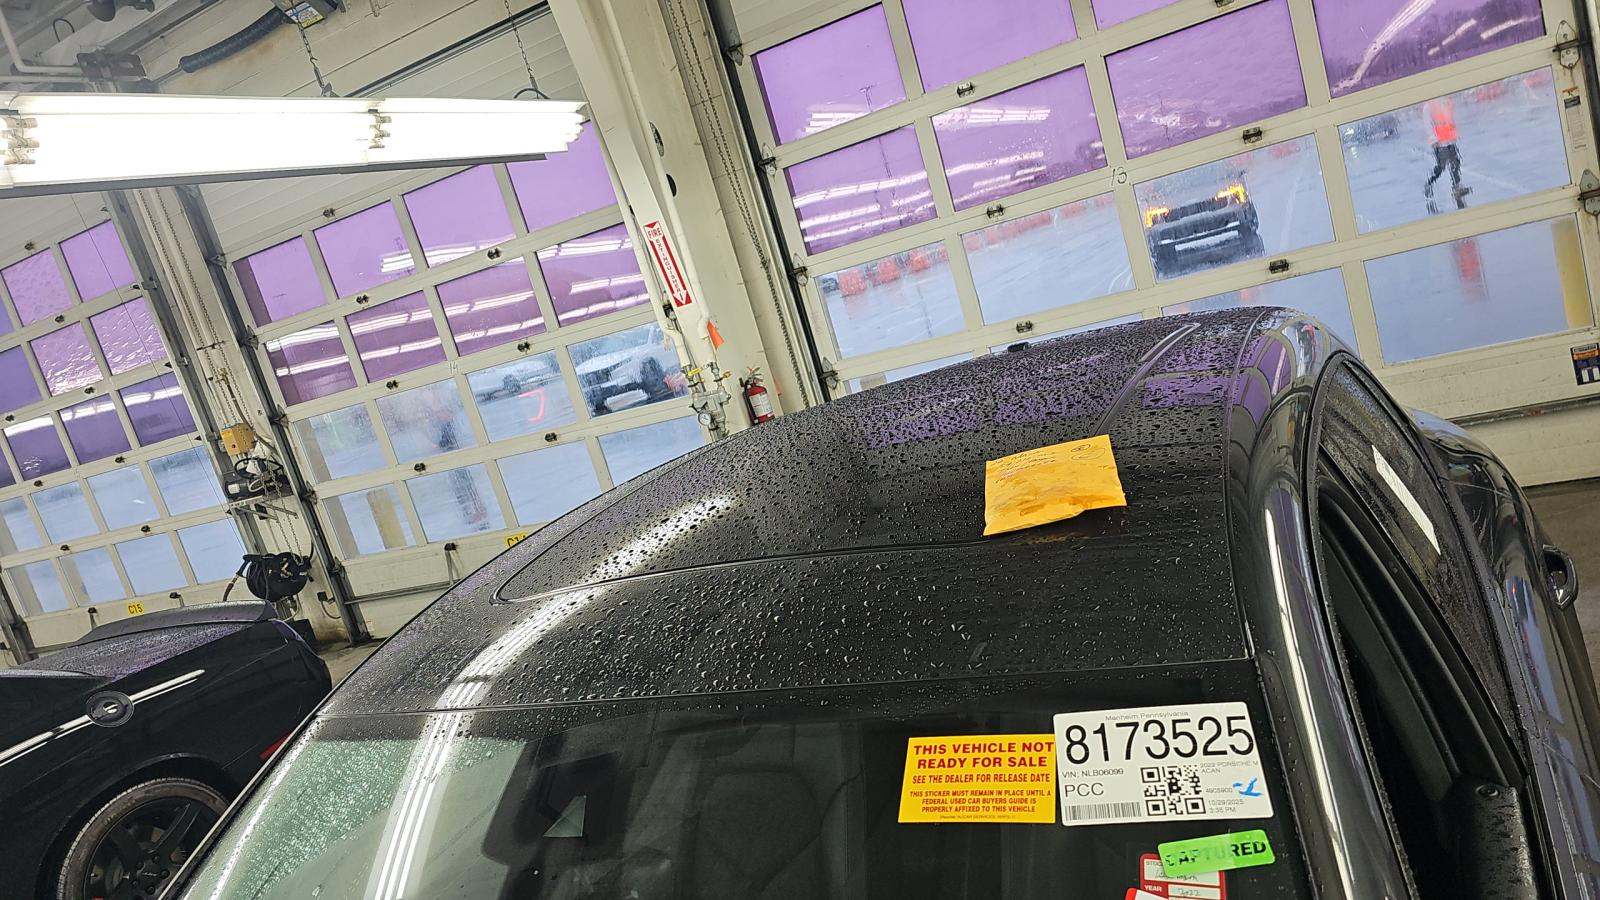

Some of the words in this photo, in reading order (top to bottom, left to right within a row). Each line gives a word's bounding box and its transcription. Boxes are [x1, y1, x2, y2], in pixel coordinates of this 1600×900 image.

[647, 227, 663, 239] FIRE
[128, 603, 143, 614] C15
[1140, 711, 1189, 719] Pennsylvania
[1065, 715, 1255, 765] 8173525
[913, 745, 947, 756] THIS
[952, 742, 1017, 754] VEHICLE
[1021, 741, 1055, 753] NOT
[917, 758, 967, 769] READY
[972, 757, 1002, 768] FOR
[1007, 756, 1048, 768] SALE
[912, 775, 926, 784] SEE
[928, 775, 943, 784] THE
[945, 774, 974, 783] DEALER
[976, 774, 991, 783] FOR
[993, 773, 1028, 783] RELEASE
[1030, 773, 1051, 783] DATE
[1026, 789, 1046, 797] UNTIL
[1064, 782, 1104, 798] PCC
